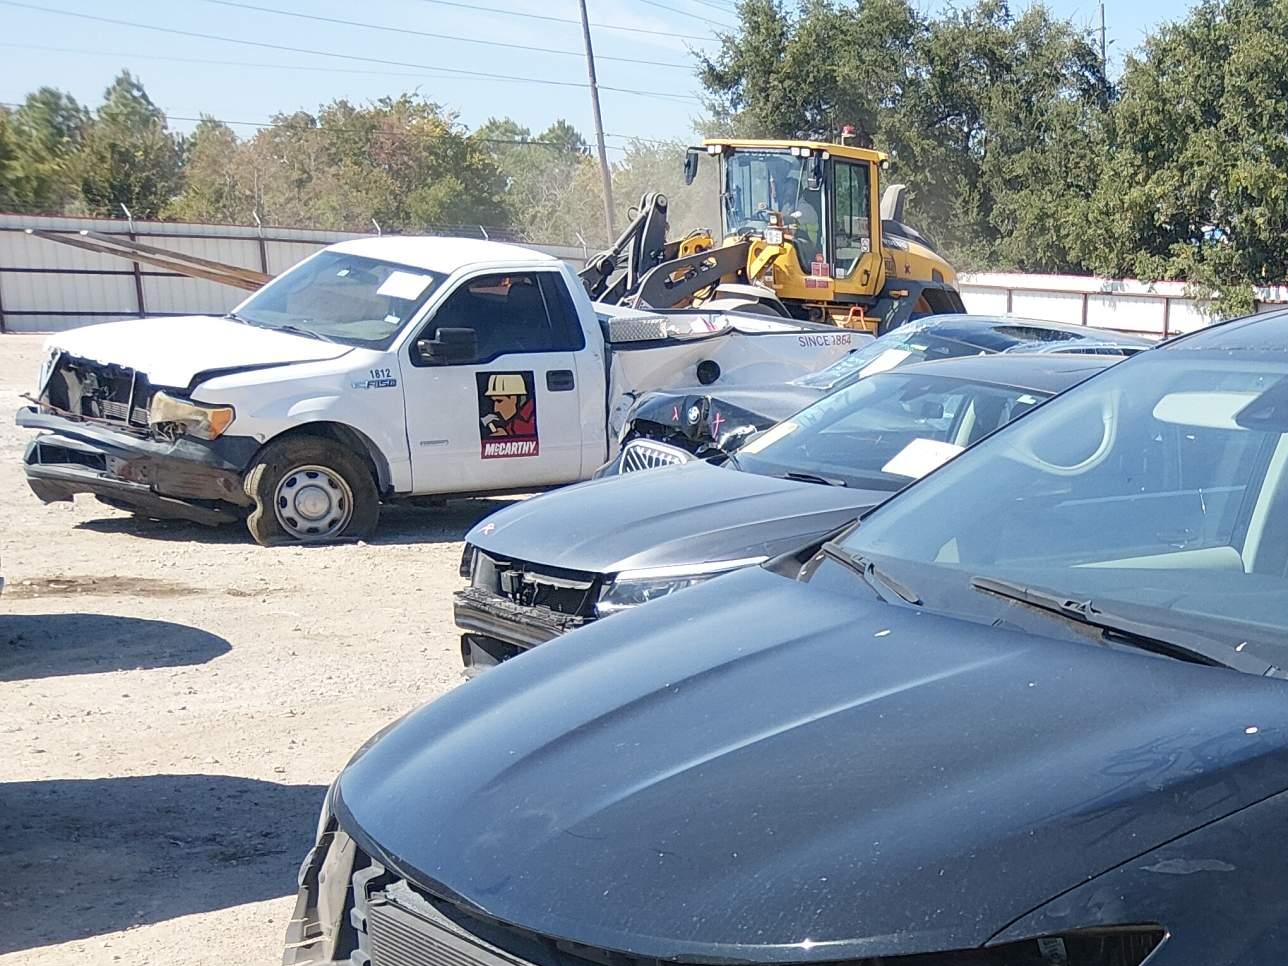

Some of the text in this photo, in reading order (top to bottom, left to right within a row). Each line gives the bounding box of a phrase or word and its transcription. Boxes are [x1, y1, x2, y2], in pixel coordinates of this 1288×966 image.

[798, 333, 852, 347] SINCE 1864
[369, 368, 392, 379] 1812
